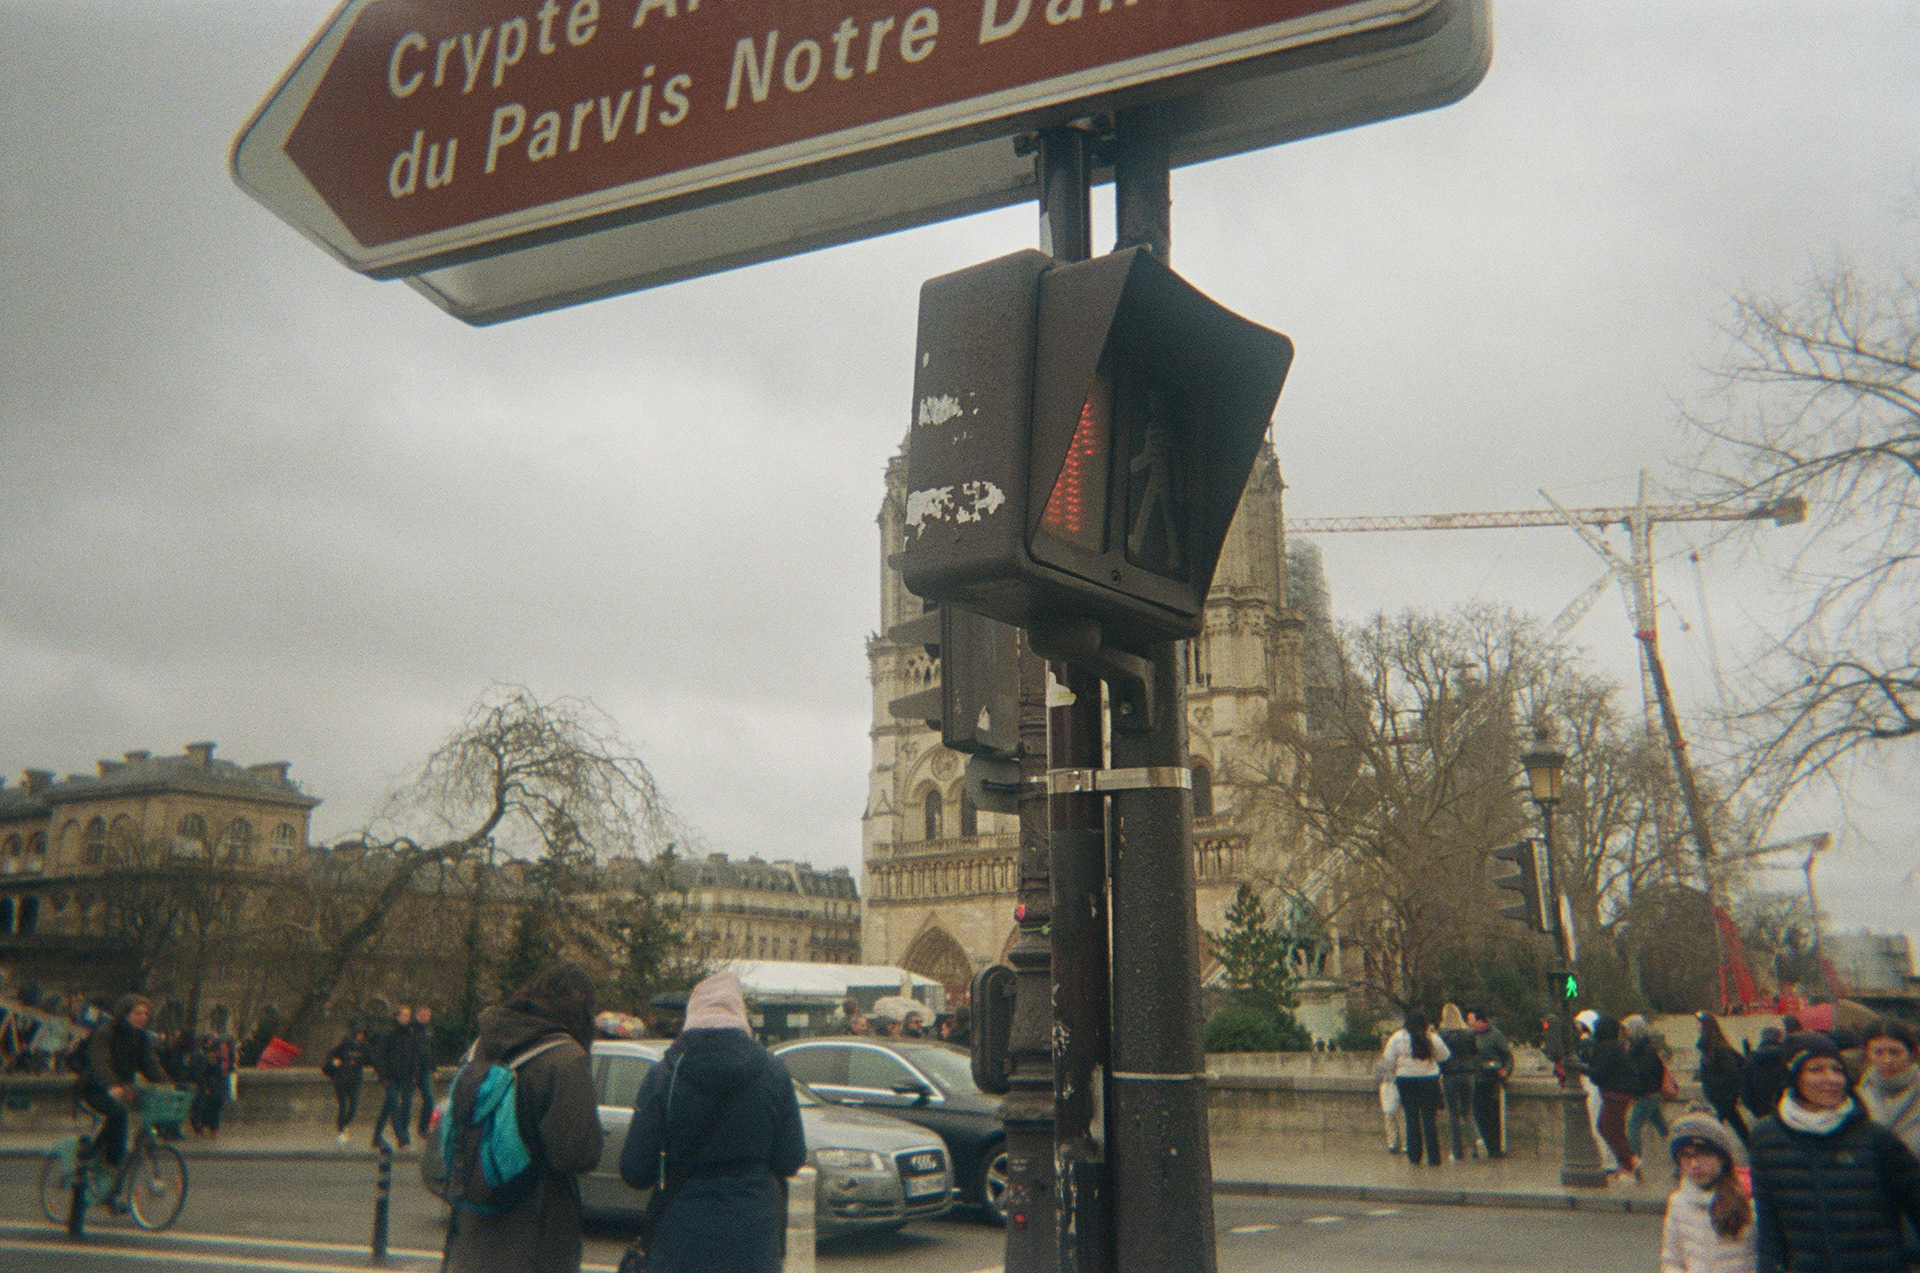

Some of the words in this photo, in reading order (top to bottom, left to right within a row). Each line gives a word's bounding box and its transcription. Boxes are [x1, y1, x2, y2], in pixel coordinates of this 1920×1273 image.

[388, 0, 600, 98] Crypte
[388, 130, 458, 198] du
[484, 64, 692, 174] Parvis
[725, 7, 940, 111] Notre
[979, 0, 1139, 45] Da
